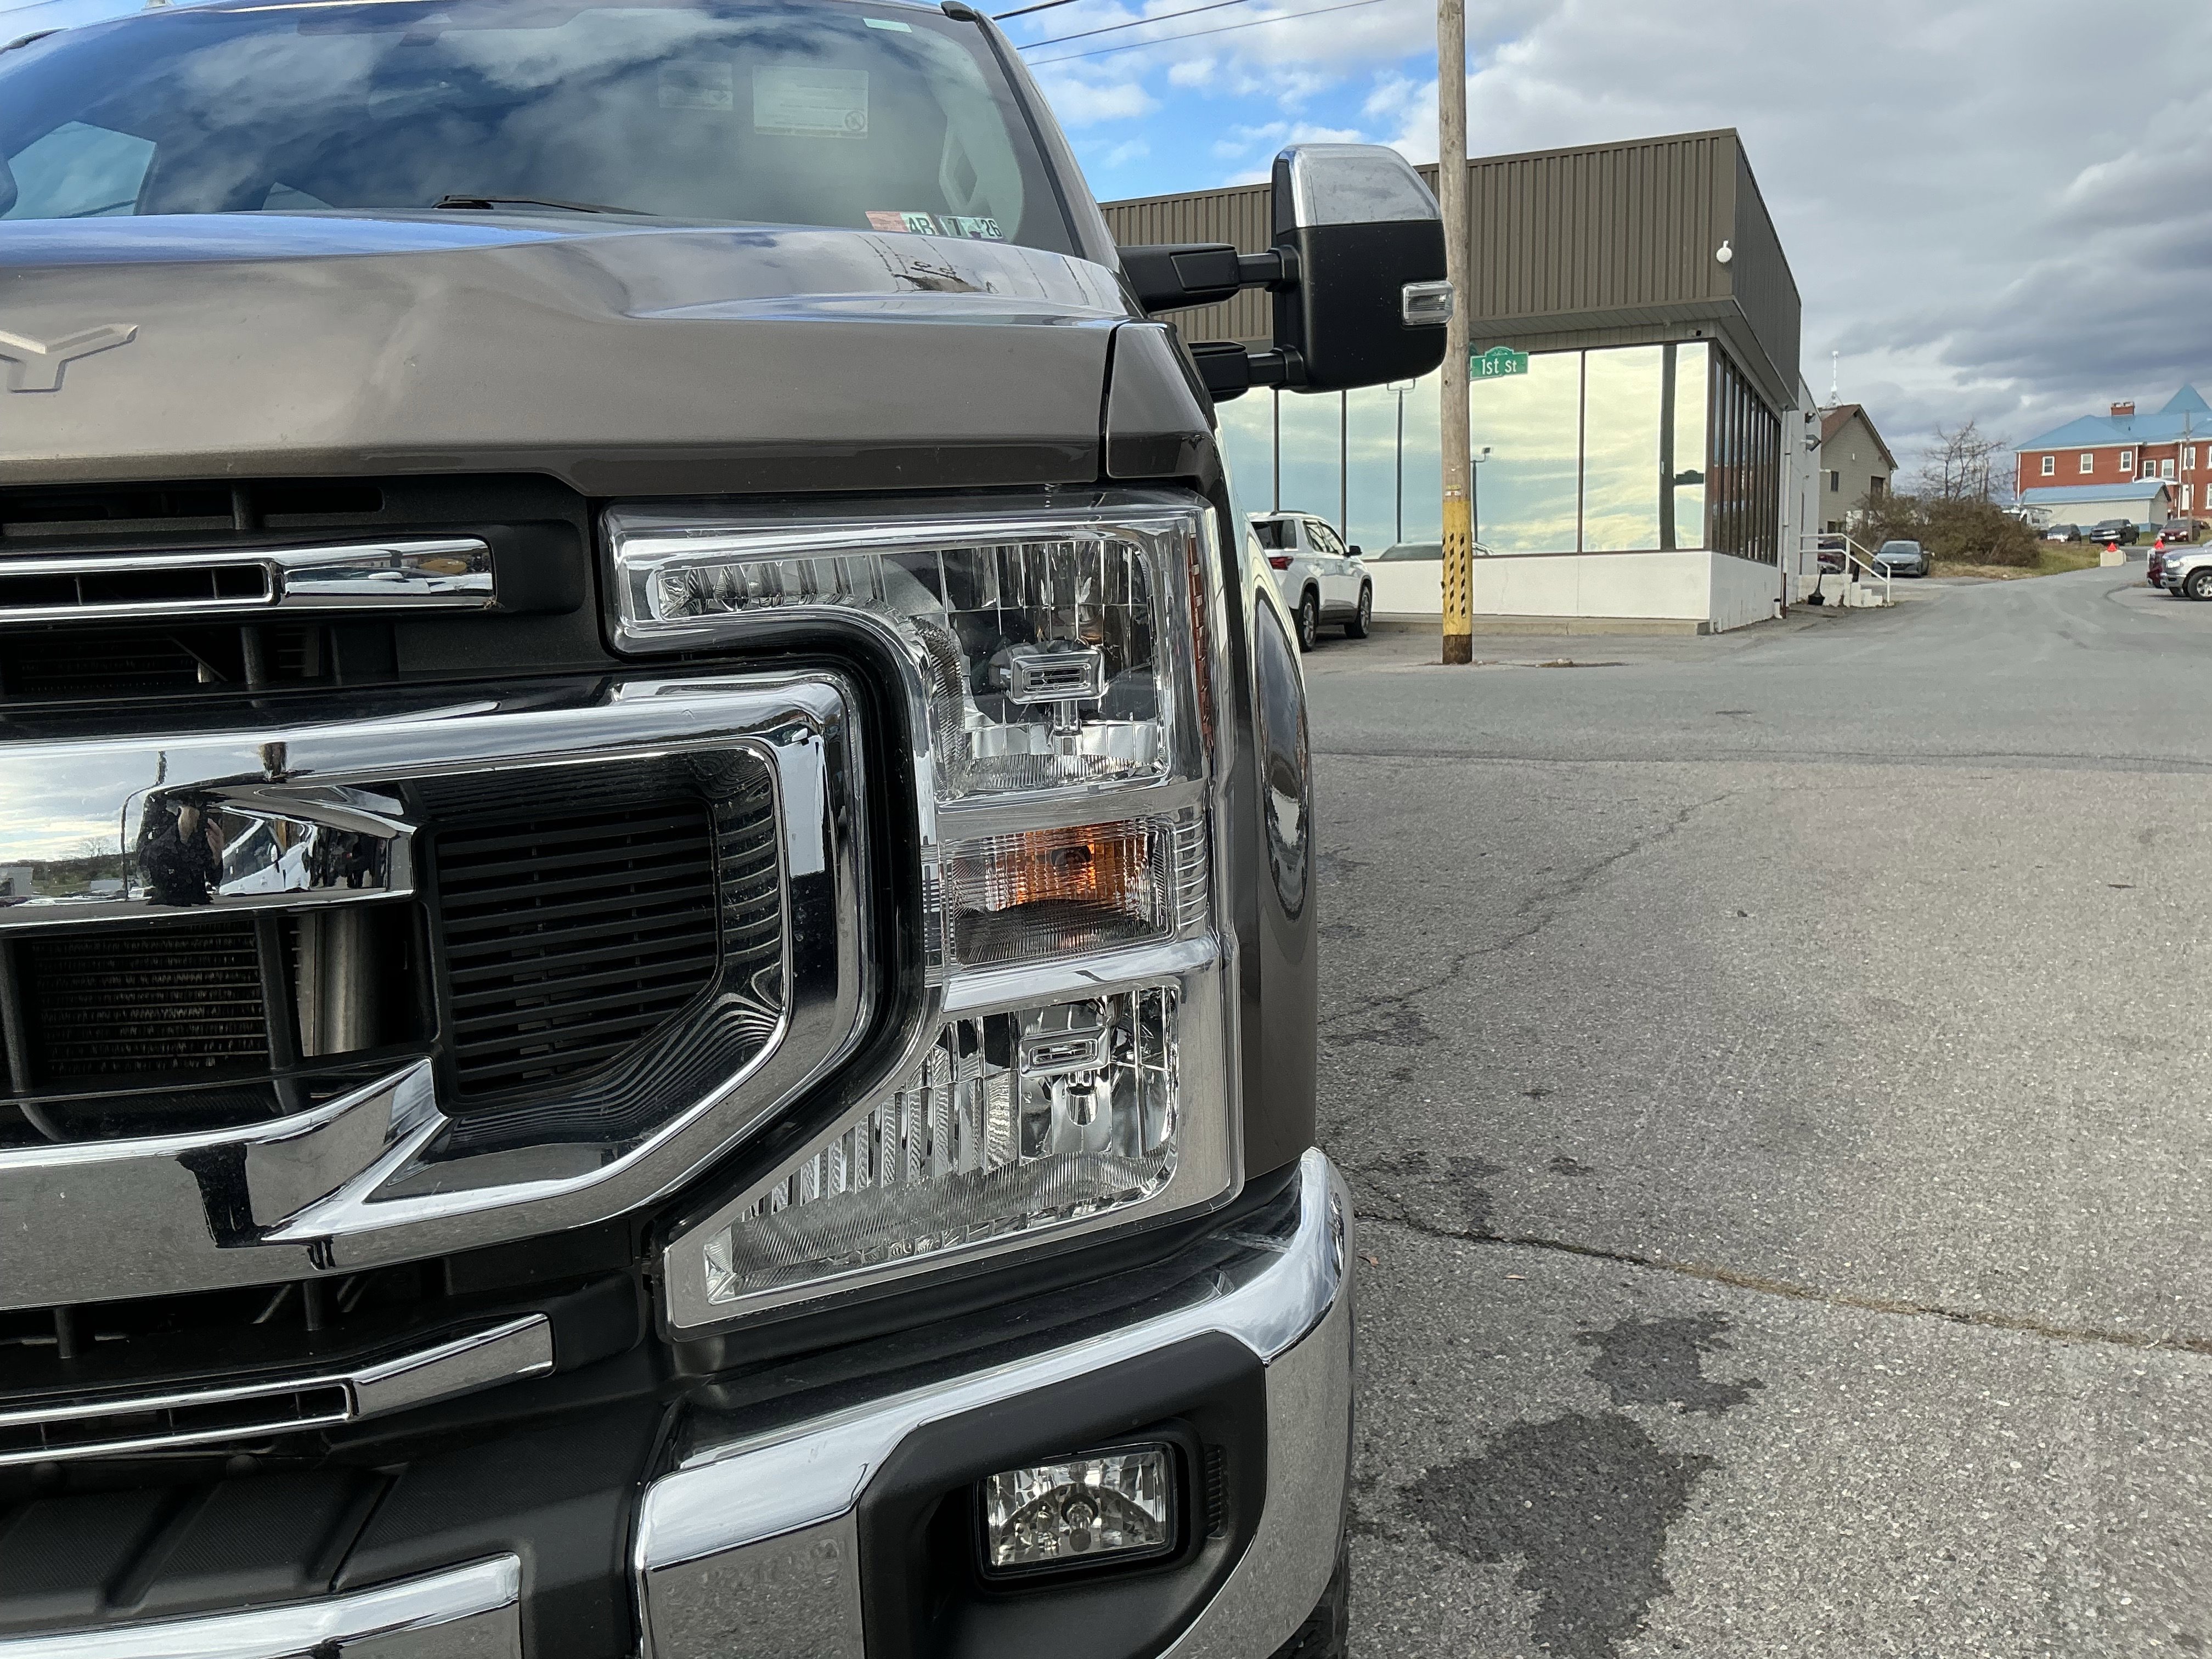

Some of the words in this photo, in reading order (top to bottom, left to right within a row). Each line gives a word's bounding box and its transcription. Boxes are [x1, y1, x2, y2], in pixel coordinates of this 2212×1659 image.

[980, 219, 1002, 236] 26
[1481, 358, 1499, 375] 1st
[1504, 359, 1517, 373] St
